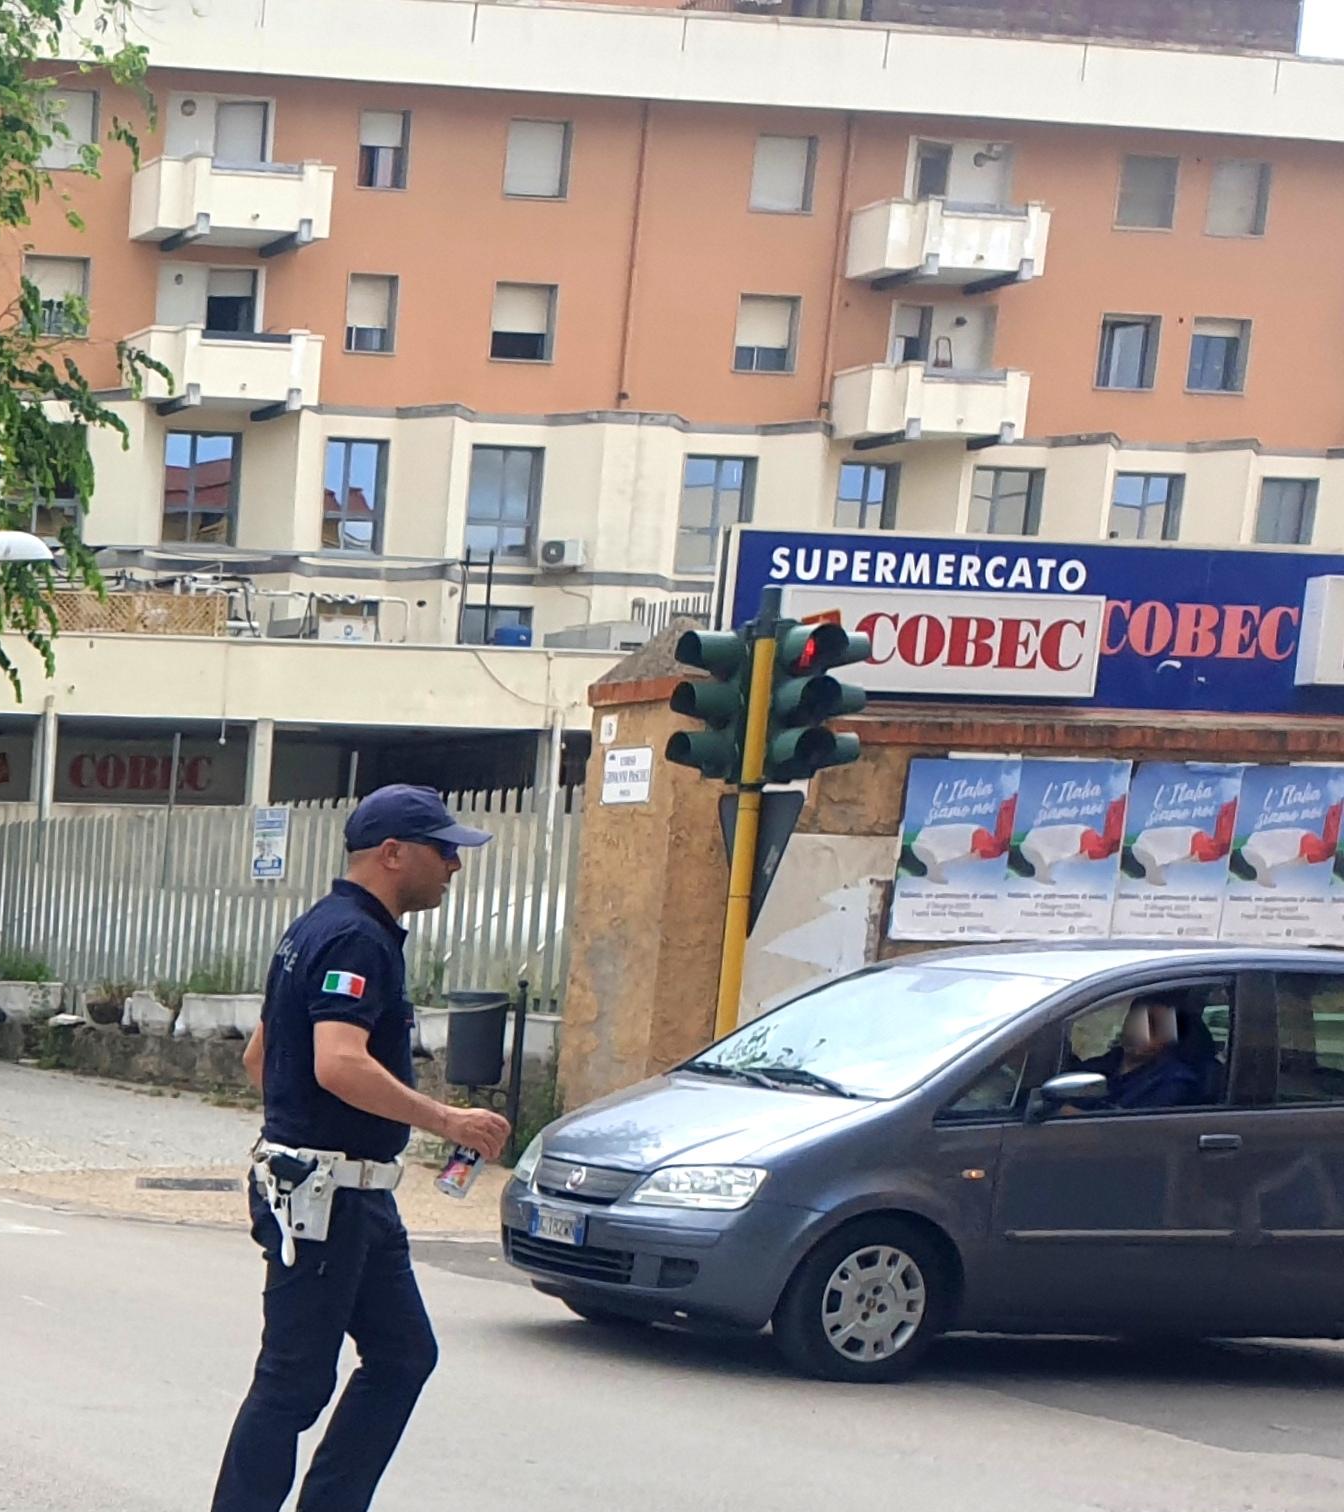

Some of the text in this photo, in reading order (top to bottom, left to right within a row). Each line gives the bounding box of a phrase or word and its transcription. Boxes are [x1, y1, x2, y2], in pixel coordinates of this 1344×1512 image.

[769, 546, 1087, 591] SUPERMERCATO
[855, 611, 1086, 671] COBEC
[1100, 599, 1300, 661] COBEC
[68, 752, 213, 792] COBEC
